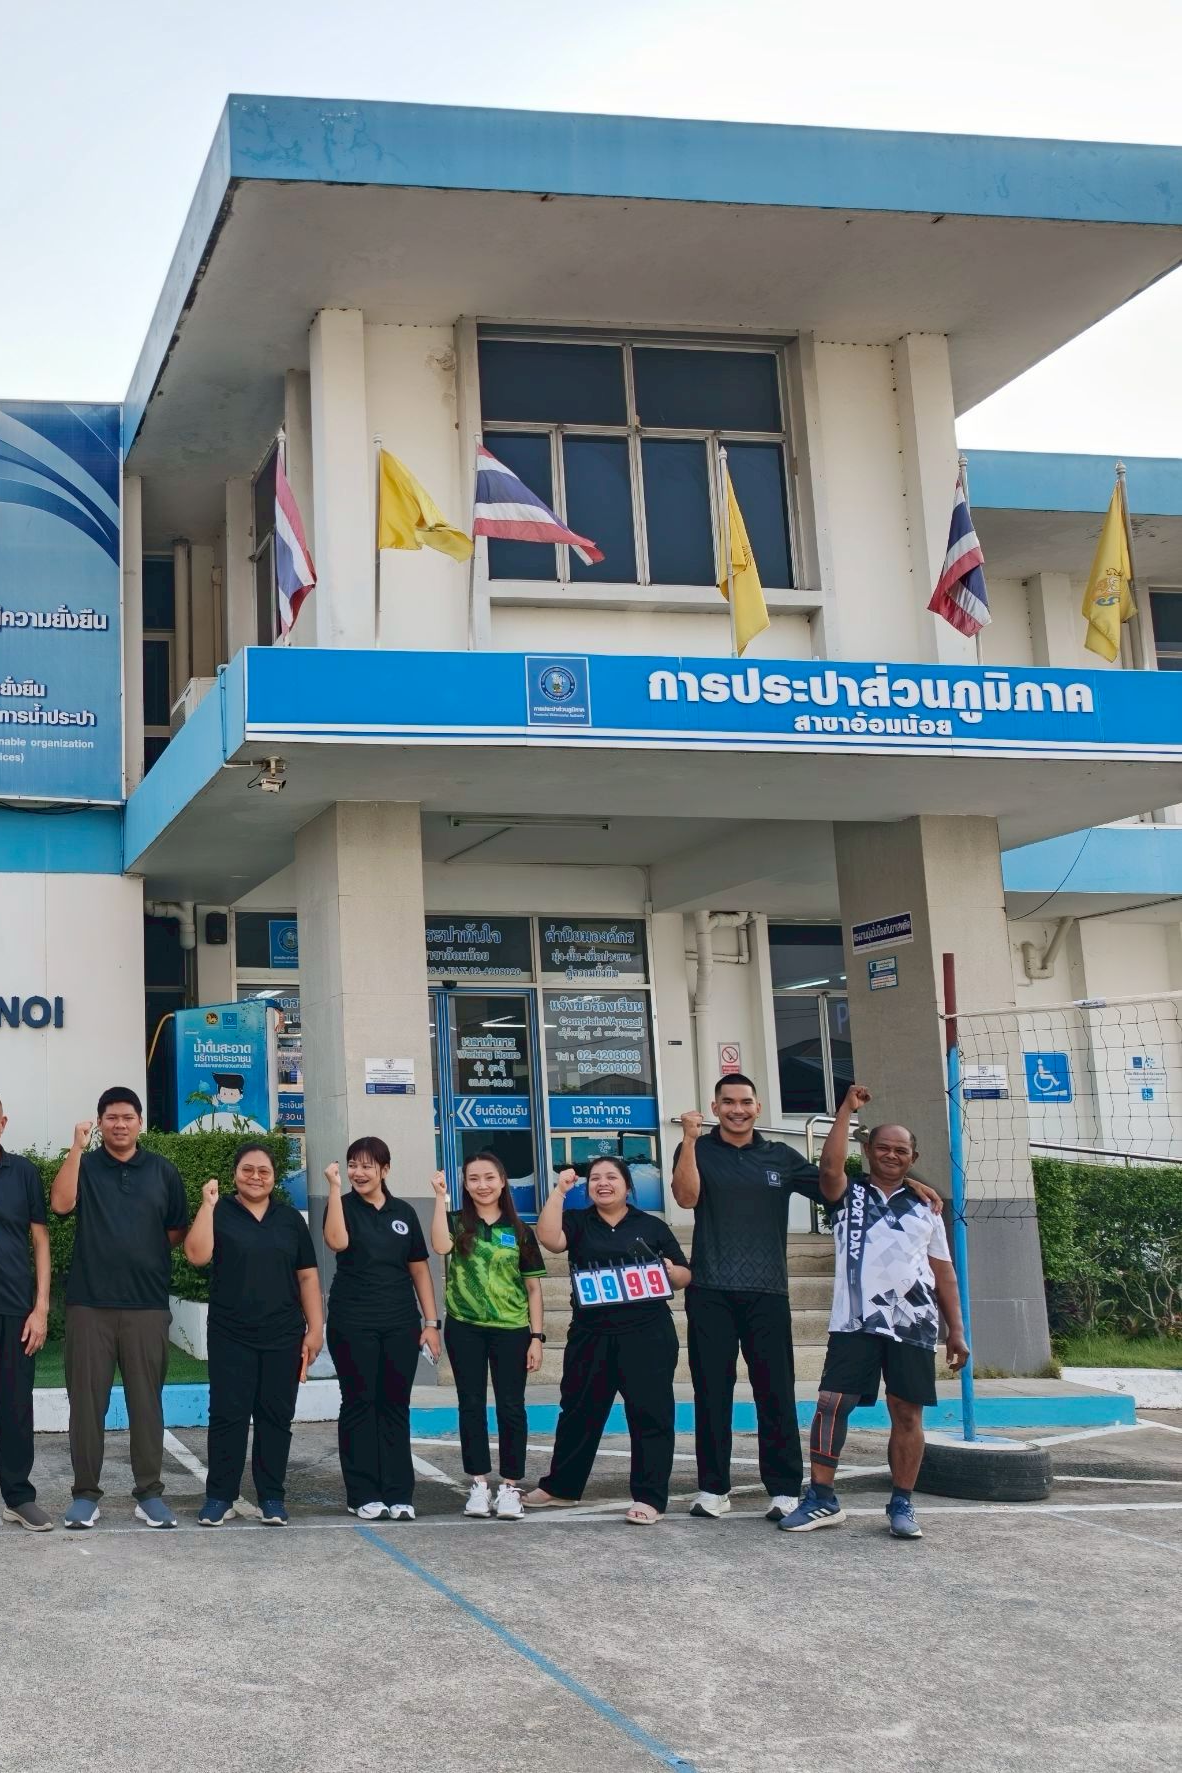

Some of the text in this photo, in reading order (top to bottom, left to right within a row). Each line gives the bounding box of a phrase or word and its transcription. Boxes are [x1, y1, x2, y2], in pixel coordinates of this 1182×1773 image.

[648, 665, 1094, 724] การประปาส่วนภูมิภาค
[794, 711, 953, 735] สาขาอ้อมน้อย
[30, 738, 94, 749] organization
[426, 923, 502, 943] ระปาทันใจ
[545, 924, 635, 944] ค่านิยมองค์กร
[426, 947, 490, 961] าขาอ้อมน้อย
[559, 1016, 643, 1028] Complaint/Appeal
[193, 1038, 252, 1053] น้ำดื่มสะอาด
[461, 1033, 516, 1047] เวลาทำการ
[193, 1054, 252, 1063] บริการประชาชน
[456, 1050, 521, 1060] Working Hours
[475, 1104, 528, 1116] ยินดีต้อนรับ
[571, 1101, 631, 1115] เวลาทำการ
[850, 1183, 866, 1227] SPORT
[849, 1229, 862, 1260] DAY
